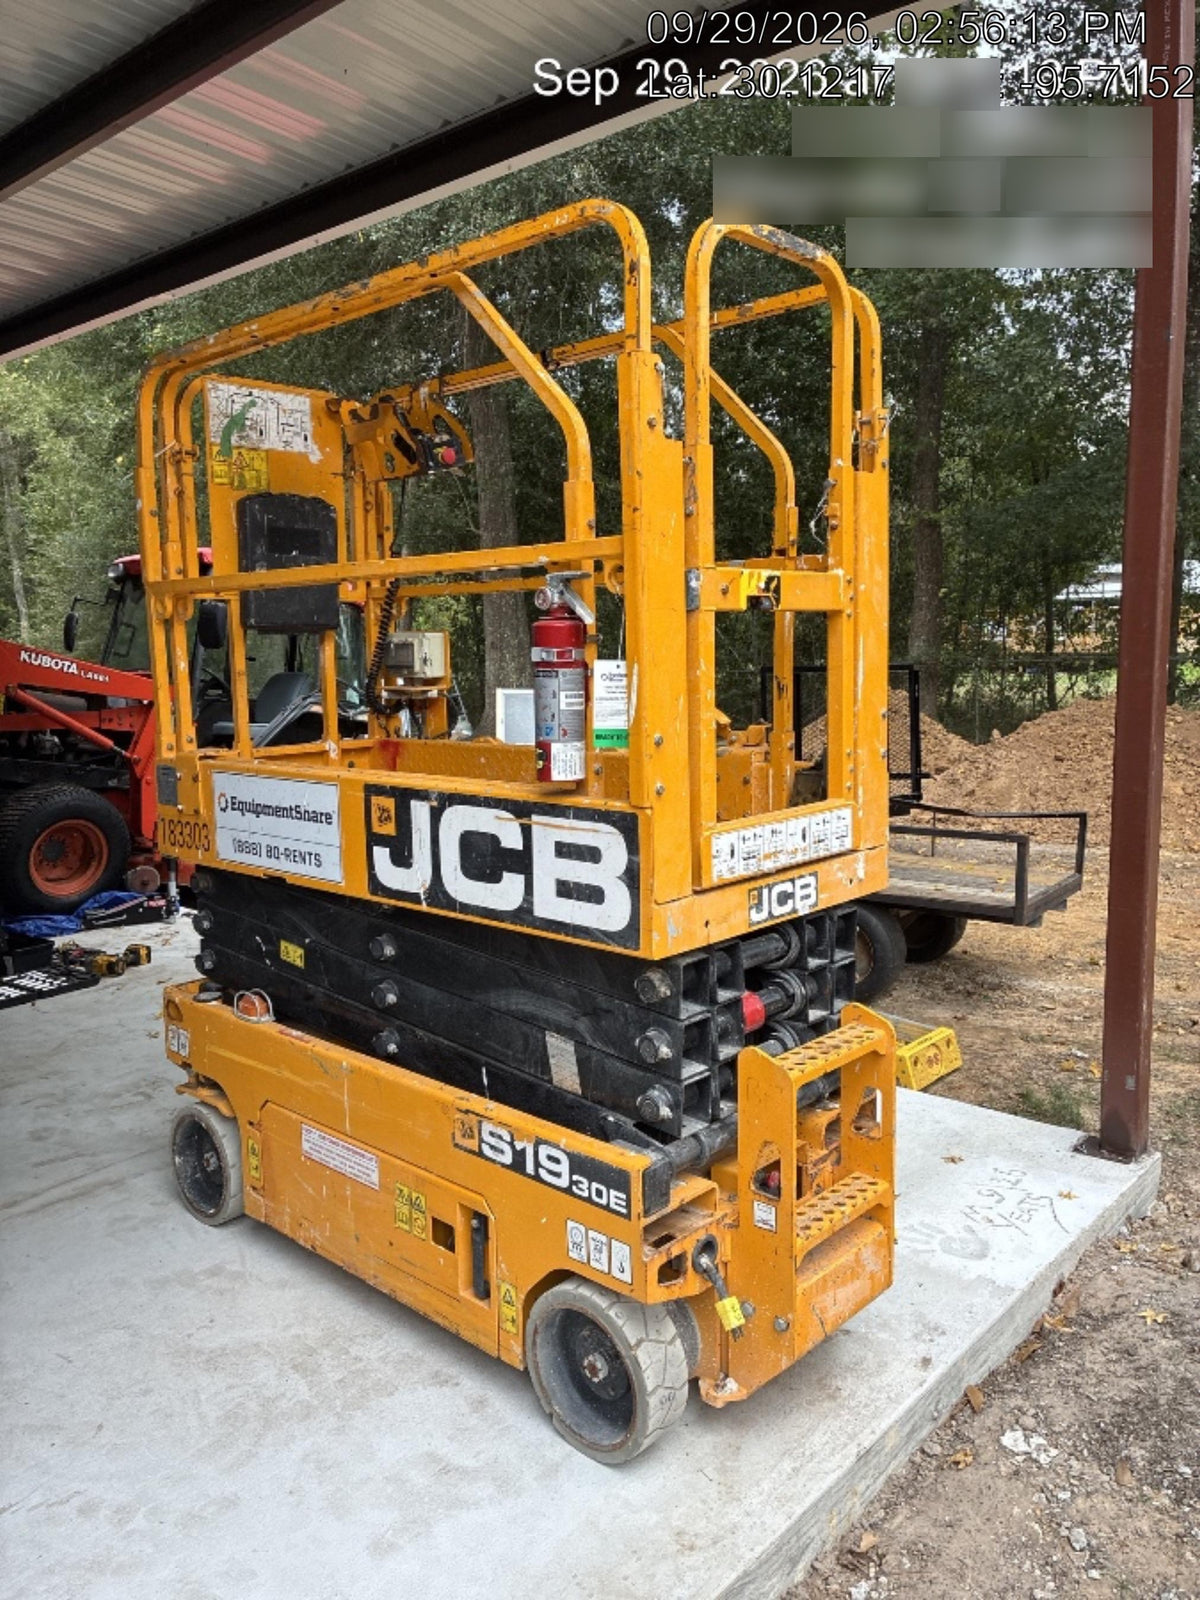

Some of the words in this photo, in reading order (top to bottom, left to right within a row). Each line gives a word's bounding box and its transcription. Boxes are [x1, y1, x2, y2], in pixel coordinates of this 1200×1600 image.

[20, 650, 79, 675] KUBOTA
[229, 795, 333, 826] EquipmentShare
[160, 817, 210, 853] 183303
[232, 838, 262, 858] (888)
[265, 843, 323, 869] 80-RENTS
[372, 799, 632, 933] JCB
[750, 874, 817, 924] JCB
[480, 1119, 570, 1189] S19
[571, 1174, 628, 1215] 30E
